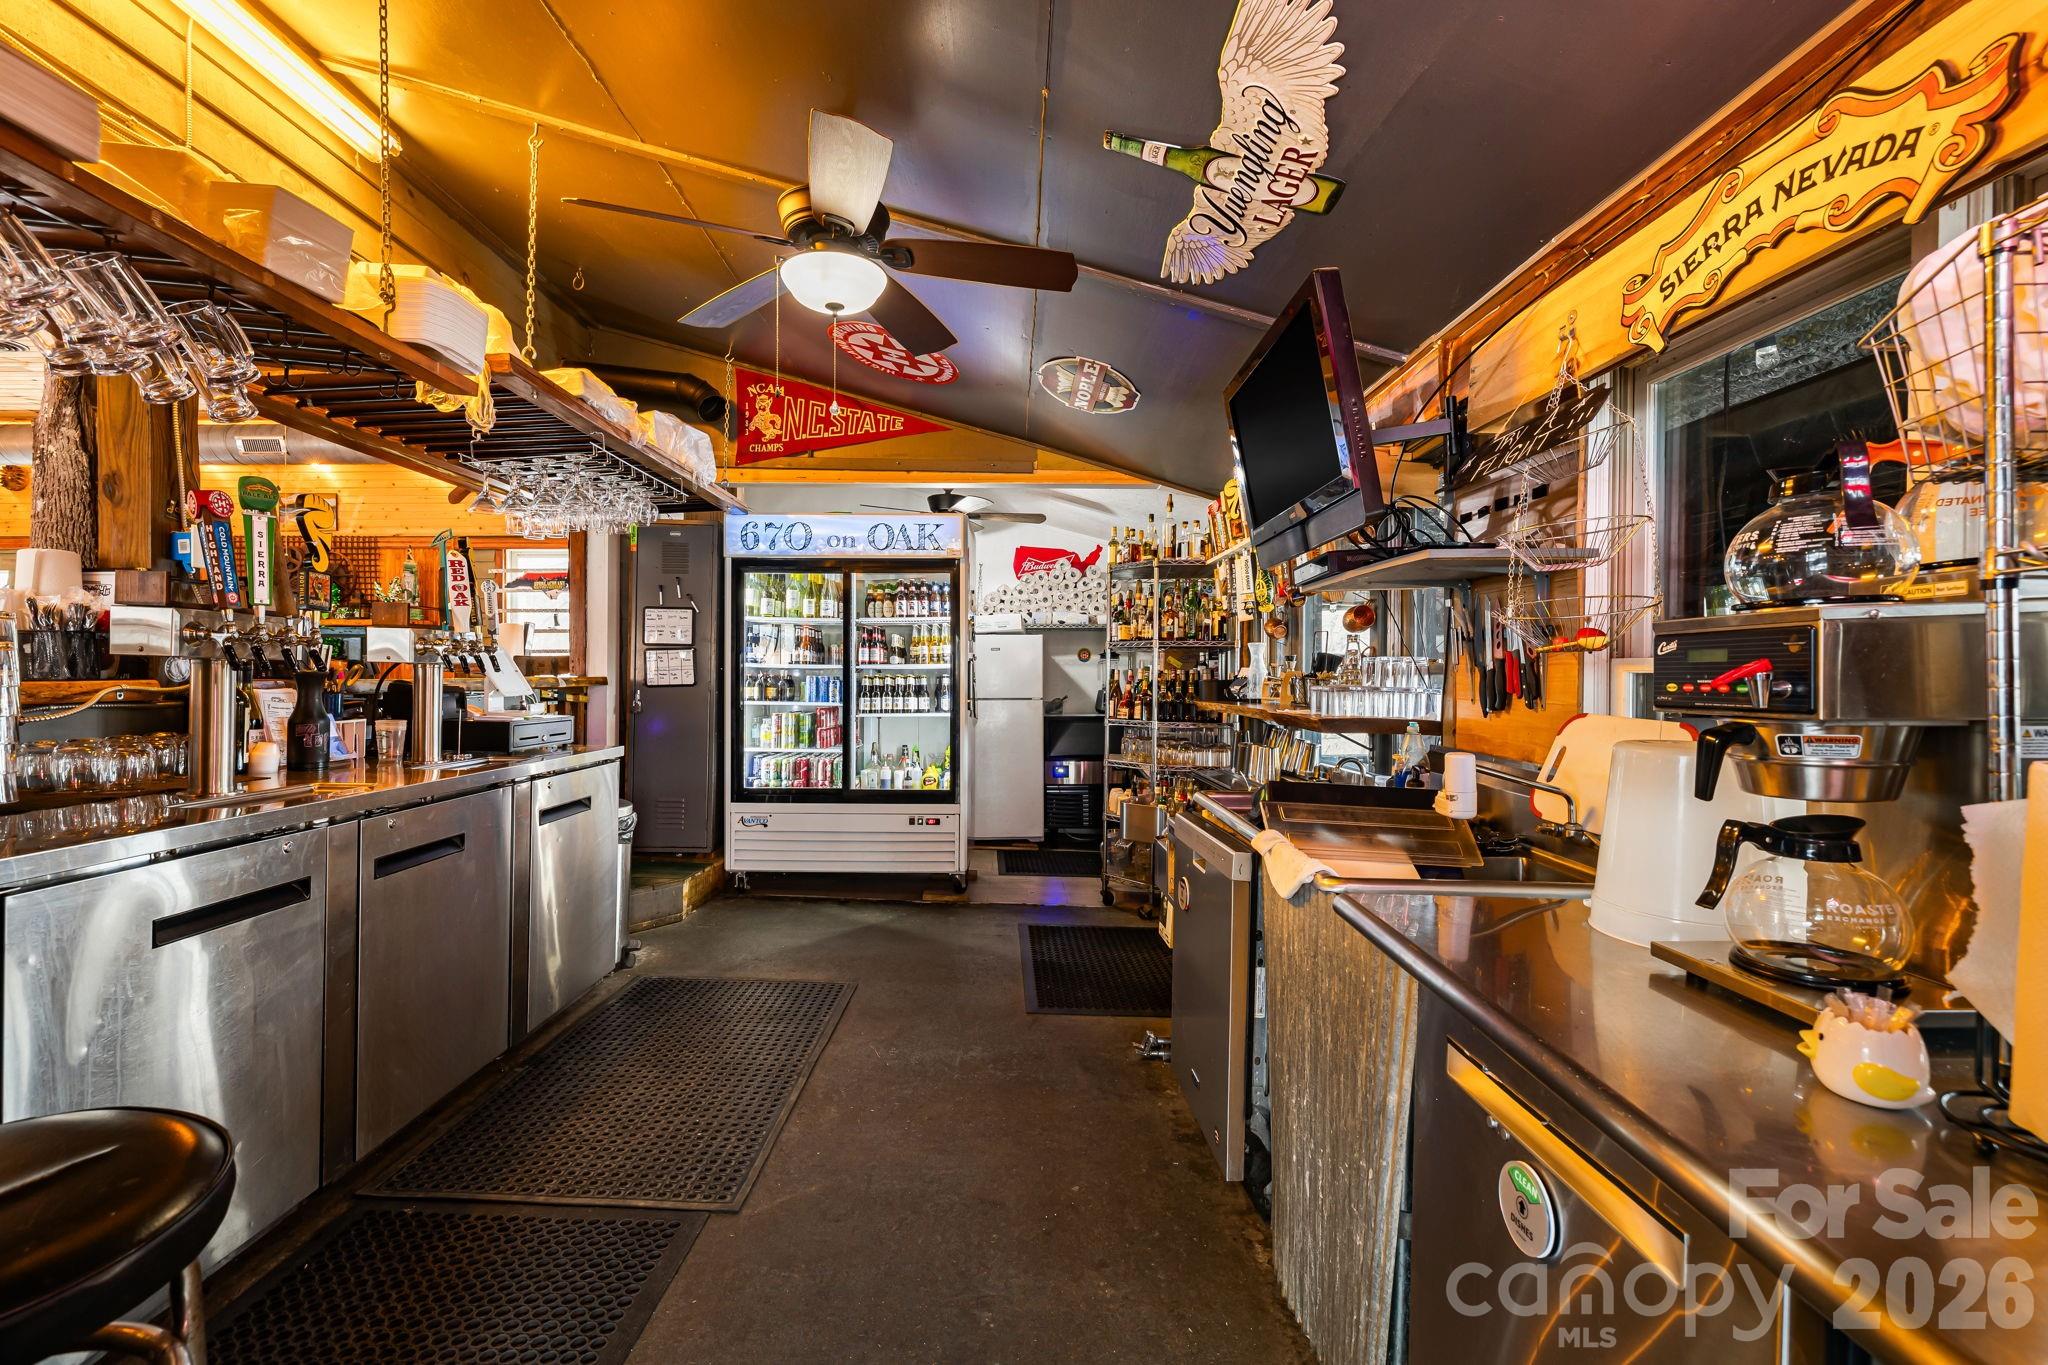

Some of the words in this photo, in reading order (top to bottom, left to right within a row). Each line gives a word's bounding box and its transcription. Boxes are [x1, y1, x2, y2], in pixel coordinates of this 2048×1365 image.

[1190, 85, 1300, 247] Yuengling
[1253, 147, 1319, 227] LAGER
[1659, 196, 1764, 302] SIERRA
[1772, 127, 1923, 213] NEVADA
[1074, 362, 1100, 409] NOBLE
[749, 443, 784, 453] CHAMPS
[1493, 425, 1529, 452] TRY
[1534, 406, 1560, 435] A
[1470, 423, 1565, 482] FLIGHT
[206, 524, 224, 591] HIGHLAND
[218, 526, 228, 548] COLD
[740, 521, 813, 551] 670
[826, 534, 857, 548] on
[867, 522, 945, 551] OAK
[222, 547, 235, 592] MOUNTAIN
[257, 531, 266, 588] SIERRA
[448, 559, 466, 582] RED
[451, 583, 470, 607] OAK
[1826, 915, 1886, 925] EXCHANGE
[1514, 1170, 1539, 1199] CLEAN
[1510, 1212, 1534, 1242] DISHES
